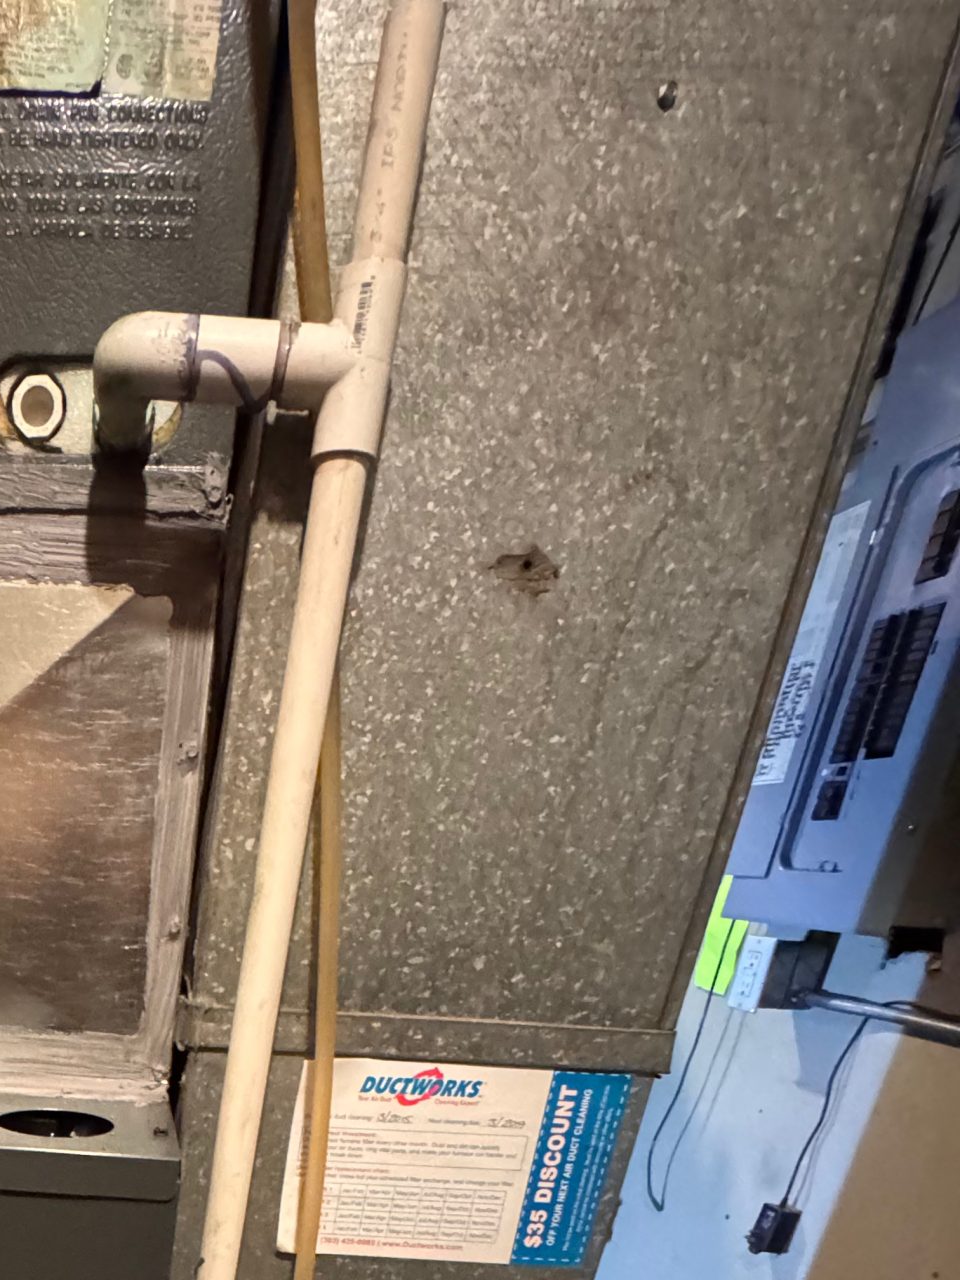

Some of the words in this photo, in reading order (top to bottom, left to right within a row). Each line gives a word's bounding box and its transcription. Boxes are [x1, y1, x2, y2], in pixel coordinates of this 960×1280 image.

[359, 1075, 483, 1098] DUCTWORKS
[573, 1088, 594, 1136] CLEANING
[534, 1084, 578, 1204] DISCOUNT
[567, 1137, 581, 1162] DUCT
[562, 1162, 574, 1179] AIR
[556, 1180, 569, 1204] NEXT
[550, 1203, 564, 1228] YOUR
[523, 1209, 548, 1249] $35
[545, 1229, 558, 1247] OFF
